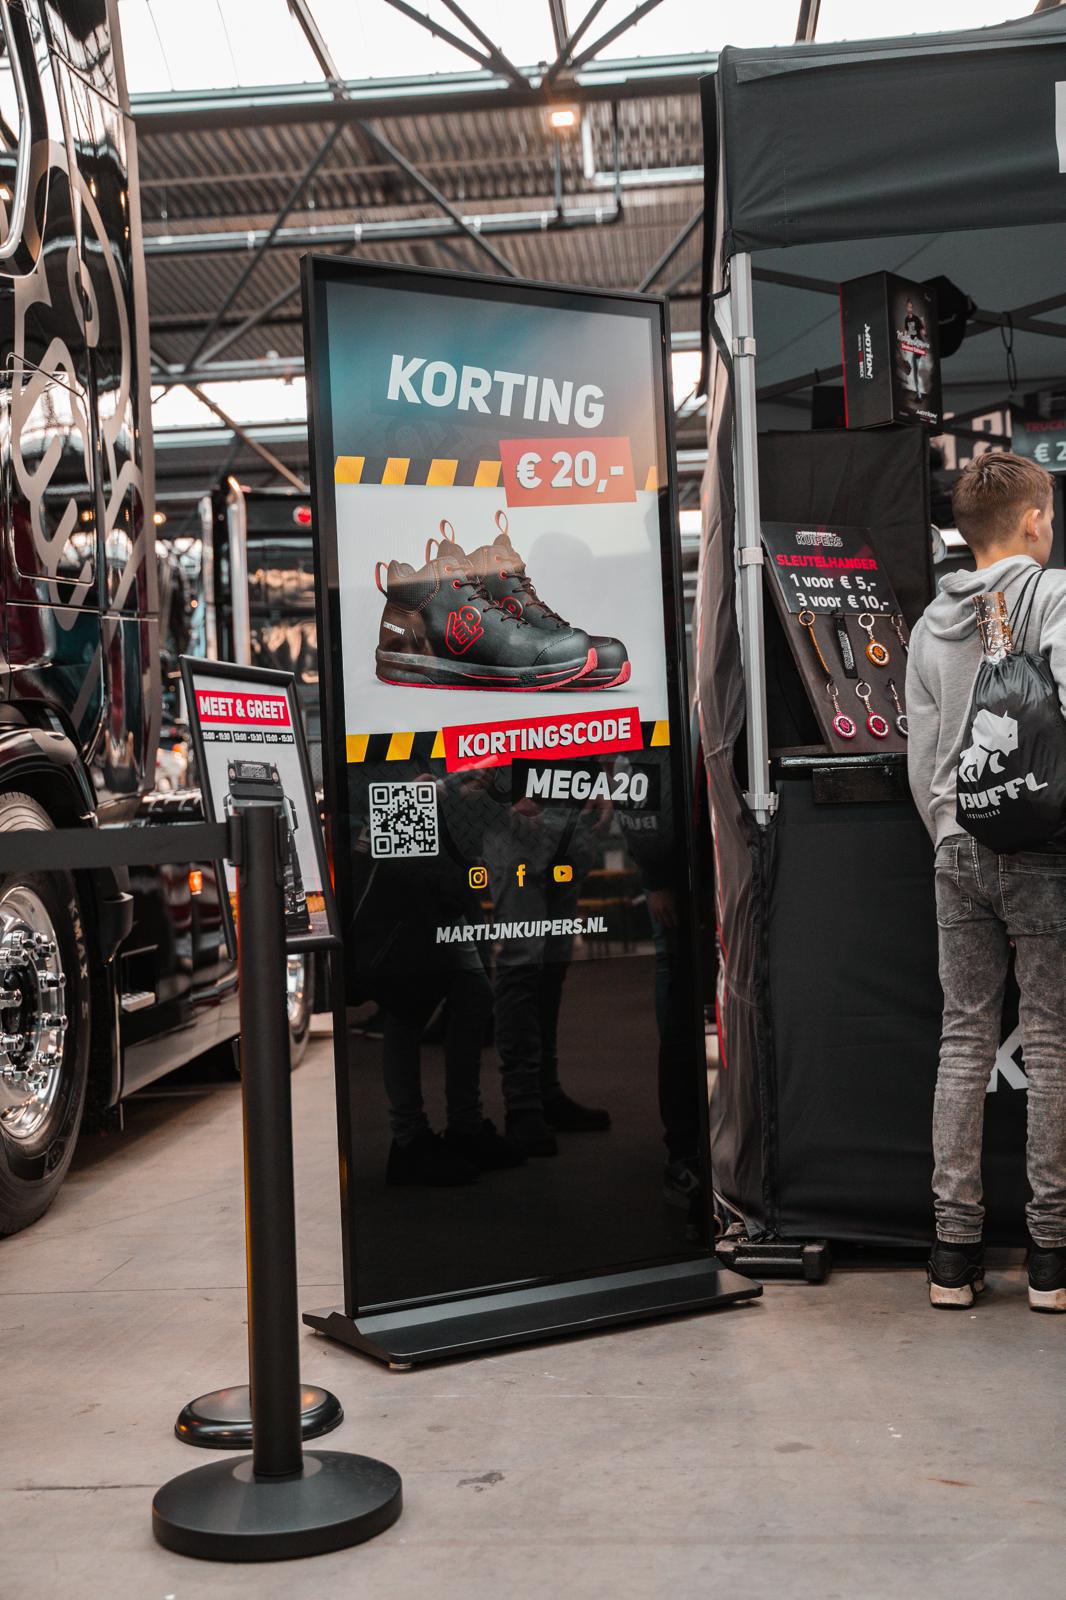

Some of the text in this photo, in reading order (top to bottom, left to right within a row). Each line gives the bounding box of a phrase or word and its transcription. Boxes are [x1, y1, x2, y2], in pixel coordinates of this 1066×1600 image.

[386, 354, 605, 428] KORTING
[516, 450, 624, 493] € 20,-
[776, 554, 878, 570] SLEUTELHANGER
[789, 573, 876, 592] 1 voor € 5,-
[796, 592, 888, 611] 3 voor € 10,-
[199, 696, 286, 720] MEET & GREET
[458, 717, 631, 758] KORTINGSCODE
[525, 768, 649, 801] MEGA20
[958, 772, 1048, 811] BUFFL
[436, 917, 608, 943] MARTIJNKUIPERS.NL
